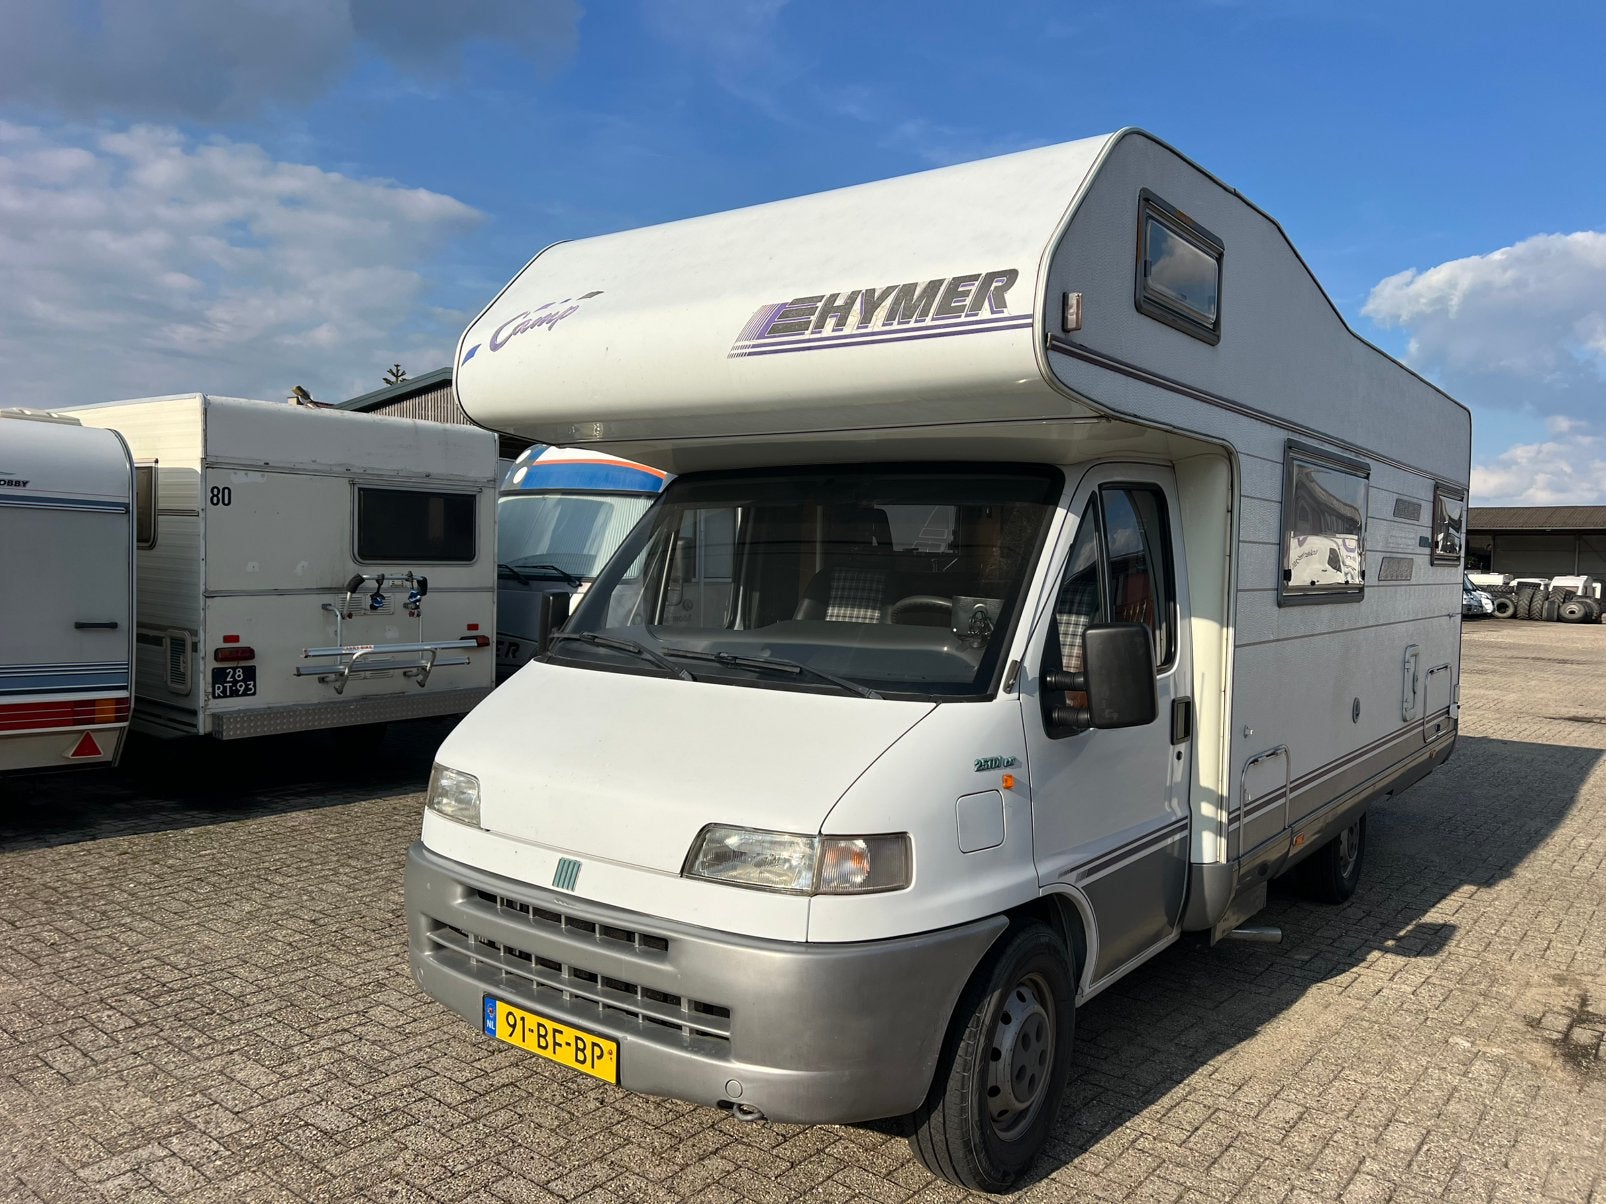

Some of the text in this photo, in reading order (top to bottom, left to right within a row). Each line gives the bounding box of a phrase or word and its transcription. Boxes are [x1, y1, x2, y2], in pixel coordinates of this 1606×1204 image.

[811, 268, 1019, 334] HYMER
[489, 305, 579, 352] Camp
[210, 486, 232, 506] 80
[226, 668, 244, 681] 28
[215, 681, 255, 697] RT-93
[486, 1019, 496, 1031] NL
[505, 1011, 605, 1070] 91-BF-BP
